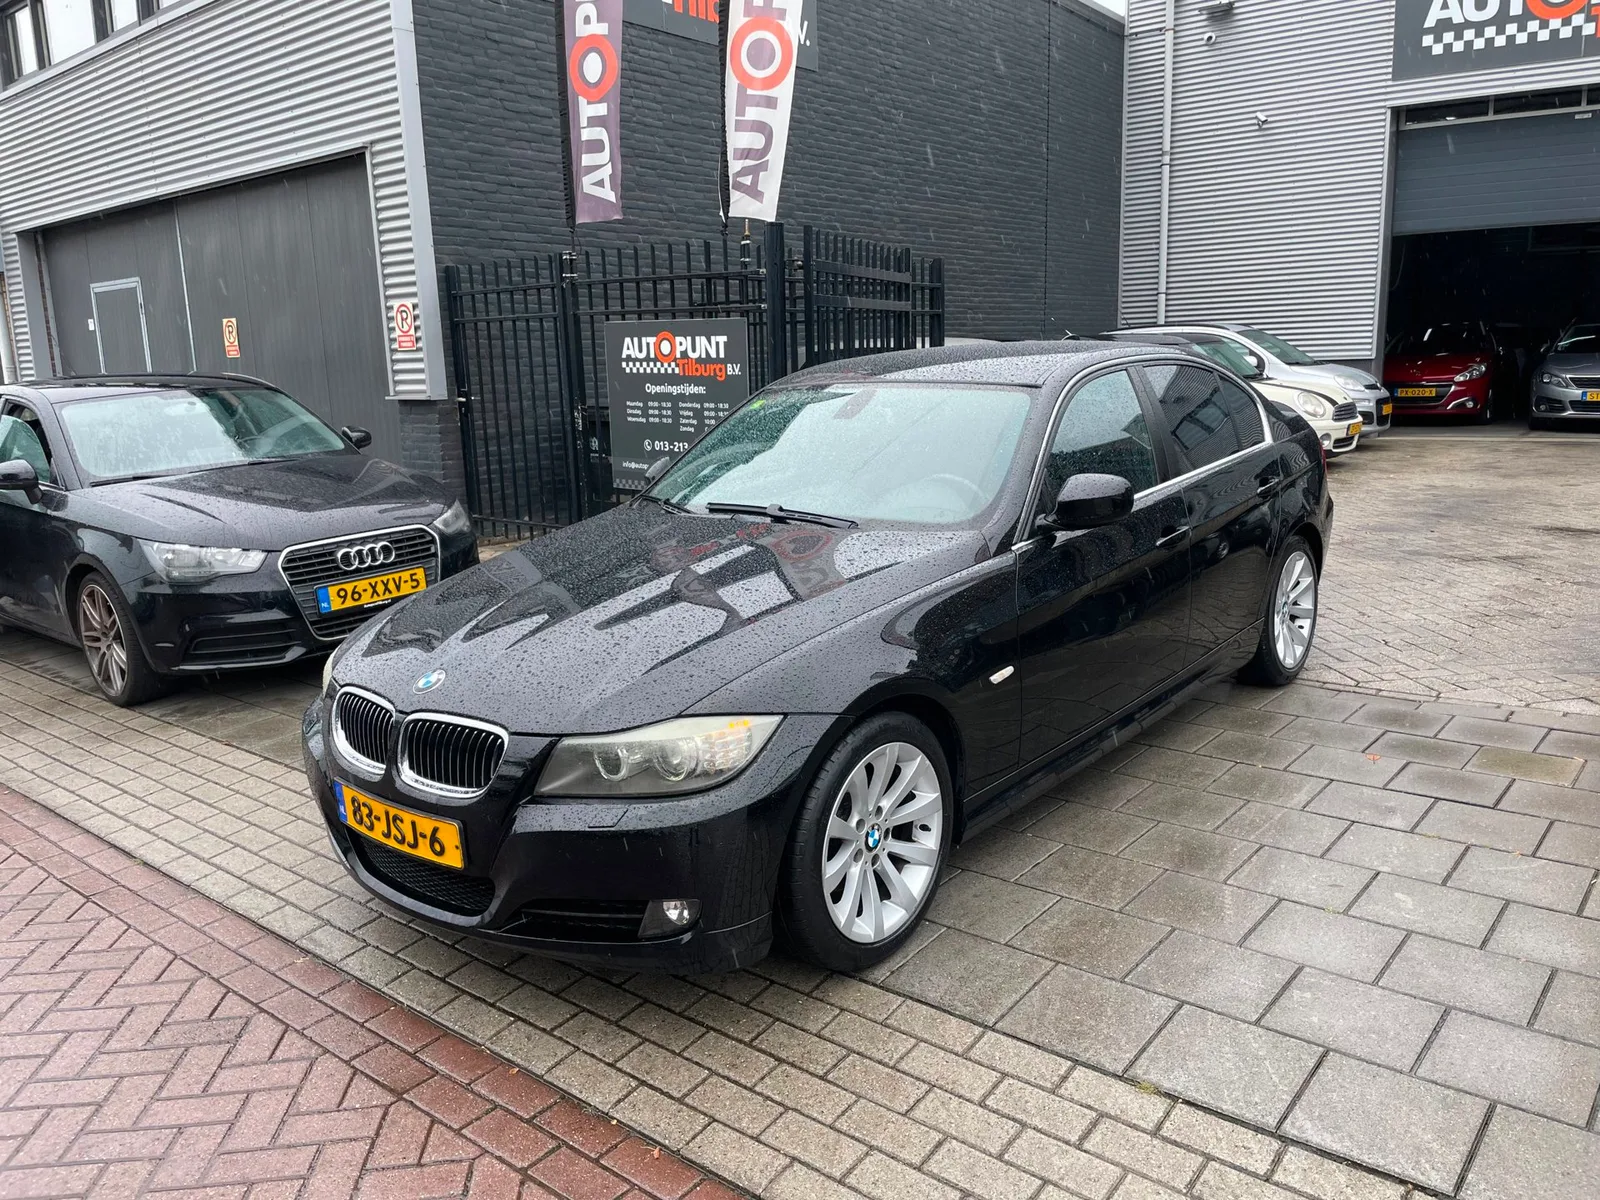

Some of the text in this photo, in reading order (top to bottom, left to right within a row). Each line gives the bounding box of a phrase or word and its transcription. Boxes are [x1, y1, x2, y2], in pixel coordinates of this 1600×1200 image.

[622, 330, 728, 364] AUTOPUNT
[676, 358, 742, 382] Tilburg B.V.
[645, 383, 706, 396] Openingstijden:
[336, 572, 421, 605] 96-XXV-5
[350, 796, 446, 857] 83-JSJ-6
